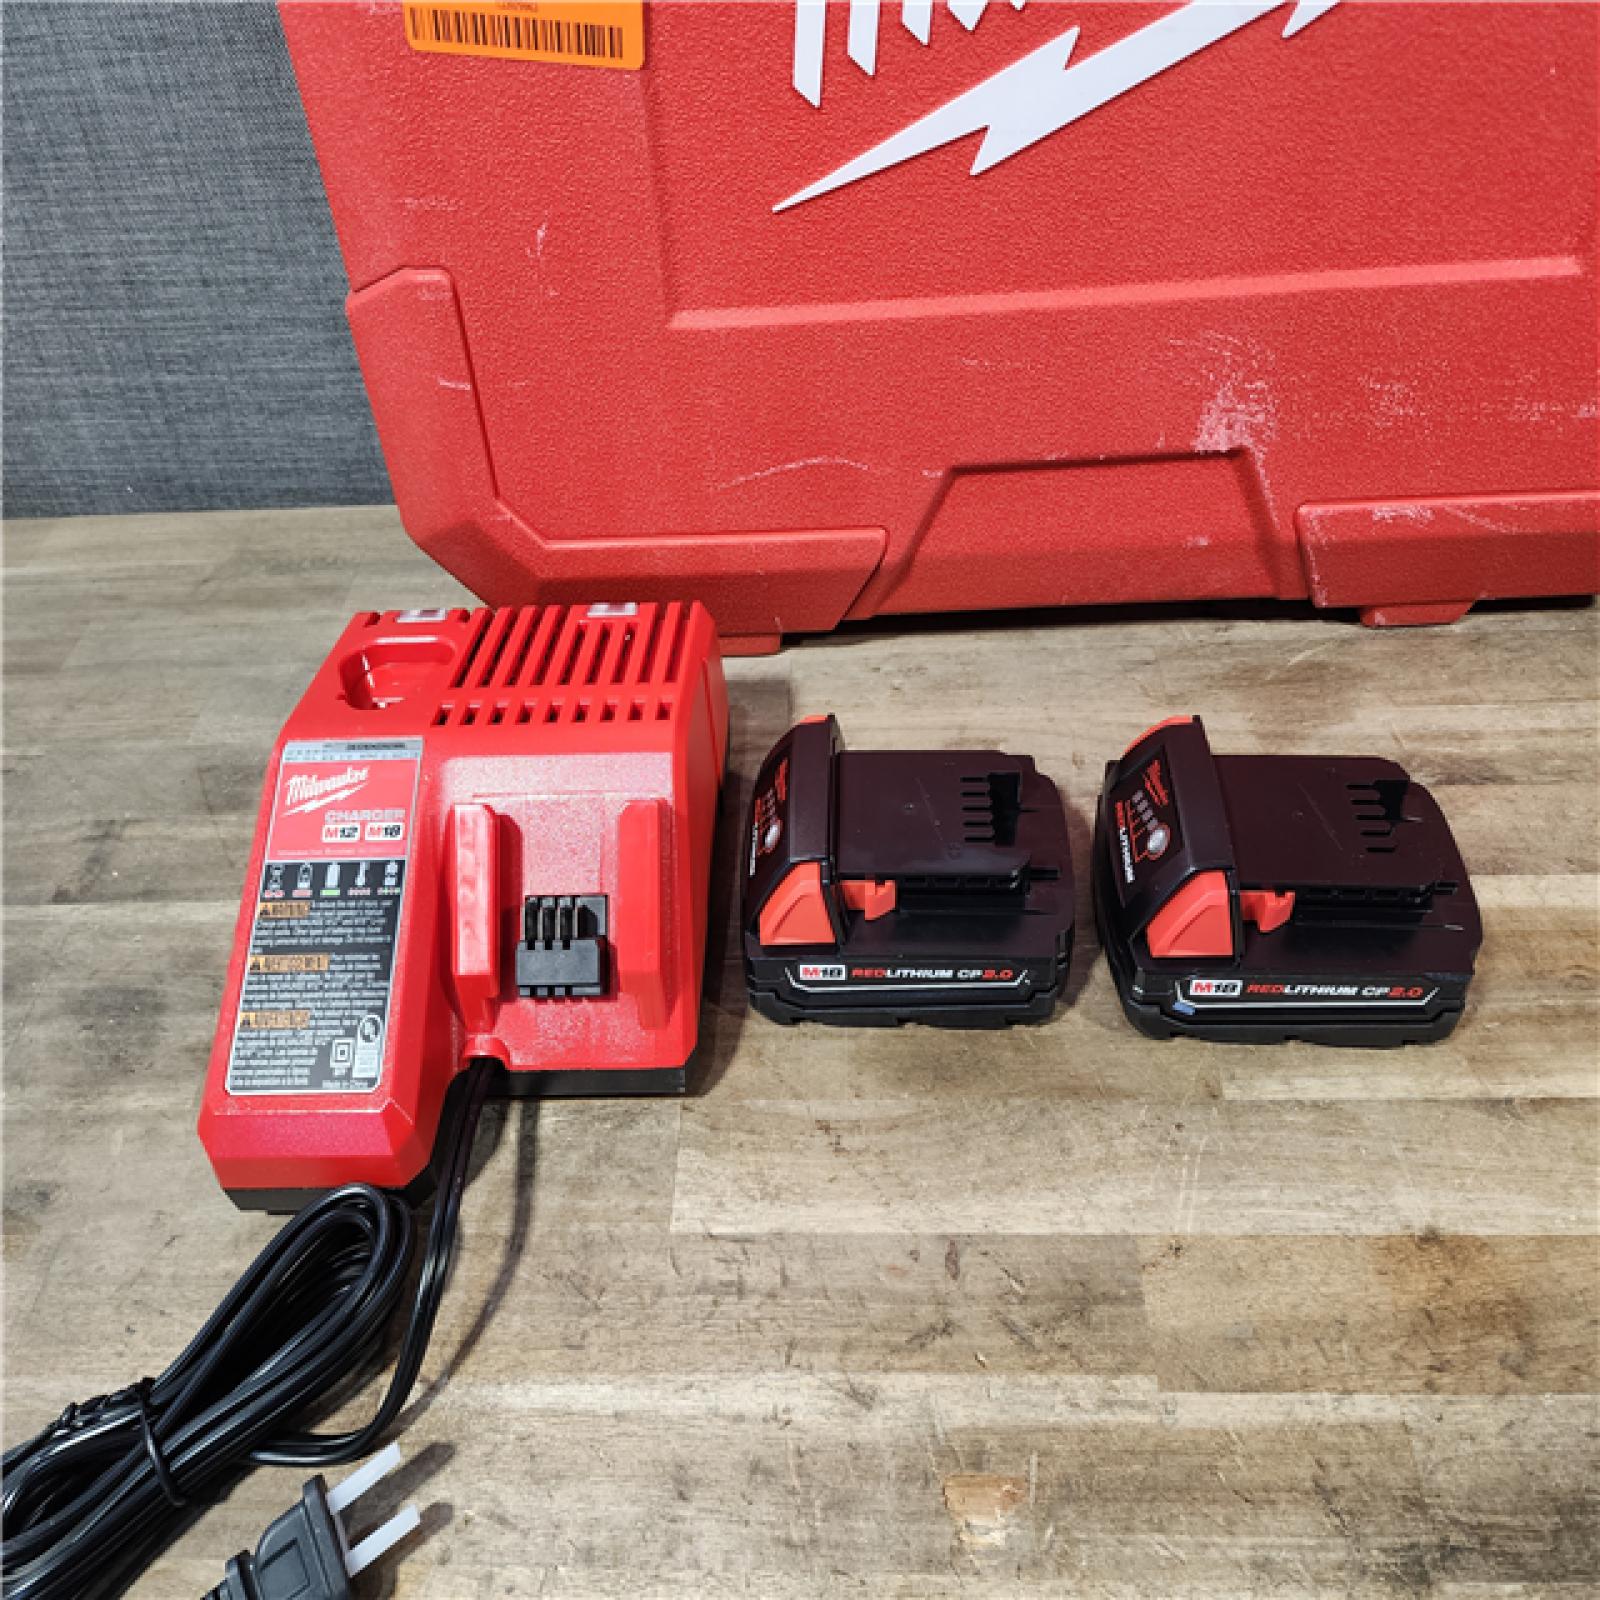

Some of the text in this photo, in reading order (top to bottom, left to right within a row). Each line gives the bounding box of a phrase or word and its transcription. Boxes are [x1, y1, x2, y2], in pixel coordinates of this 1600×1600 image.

[325, 824, 401, 839] M12 M18
[801, 966, 843, 979] M18
[851, 969, 954, 979] REDLITHIUM
[1191, 981, 1239, 994] M18
[1247, 984, 1359, 996] REDLITHIUM
